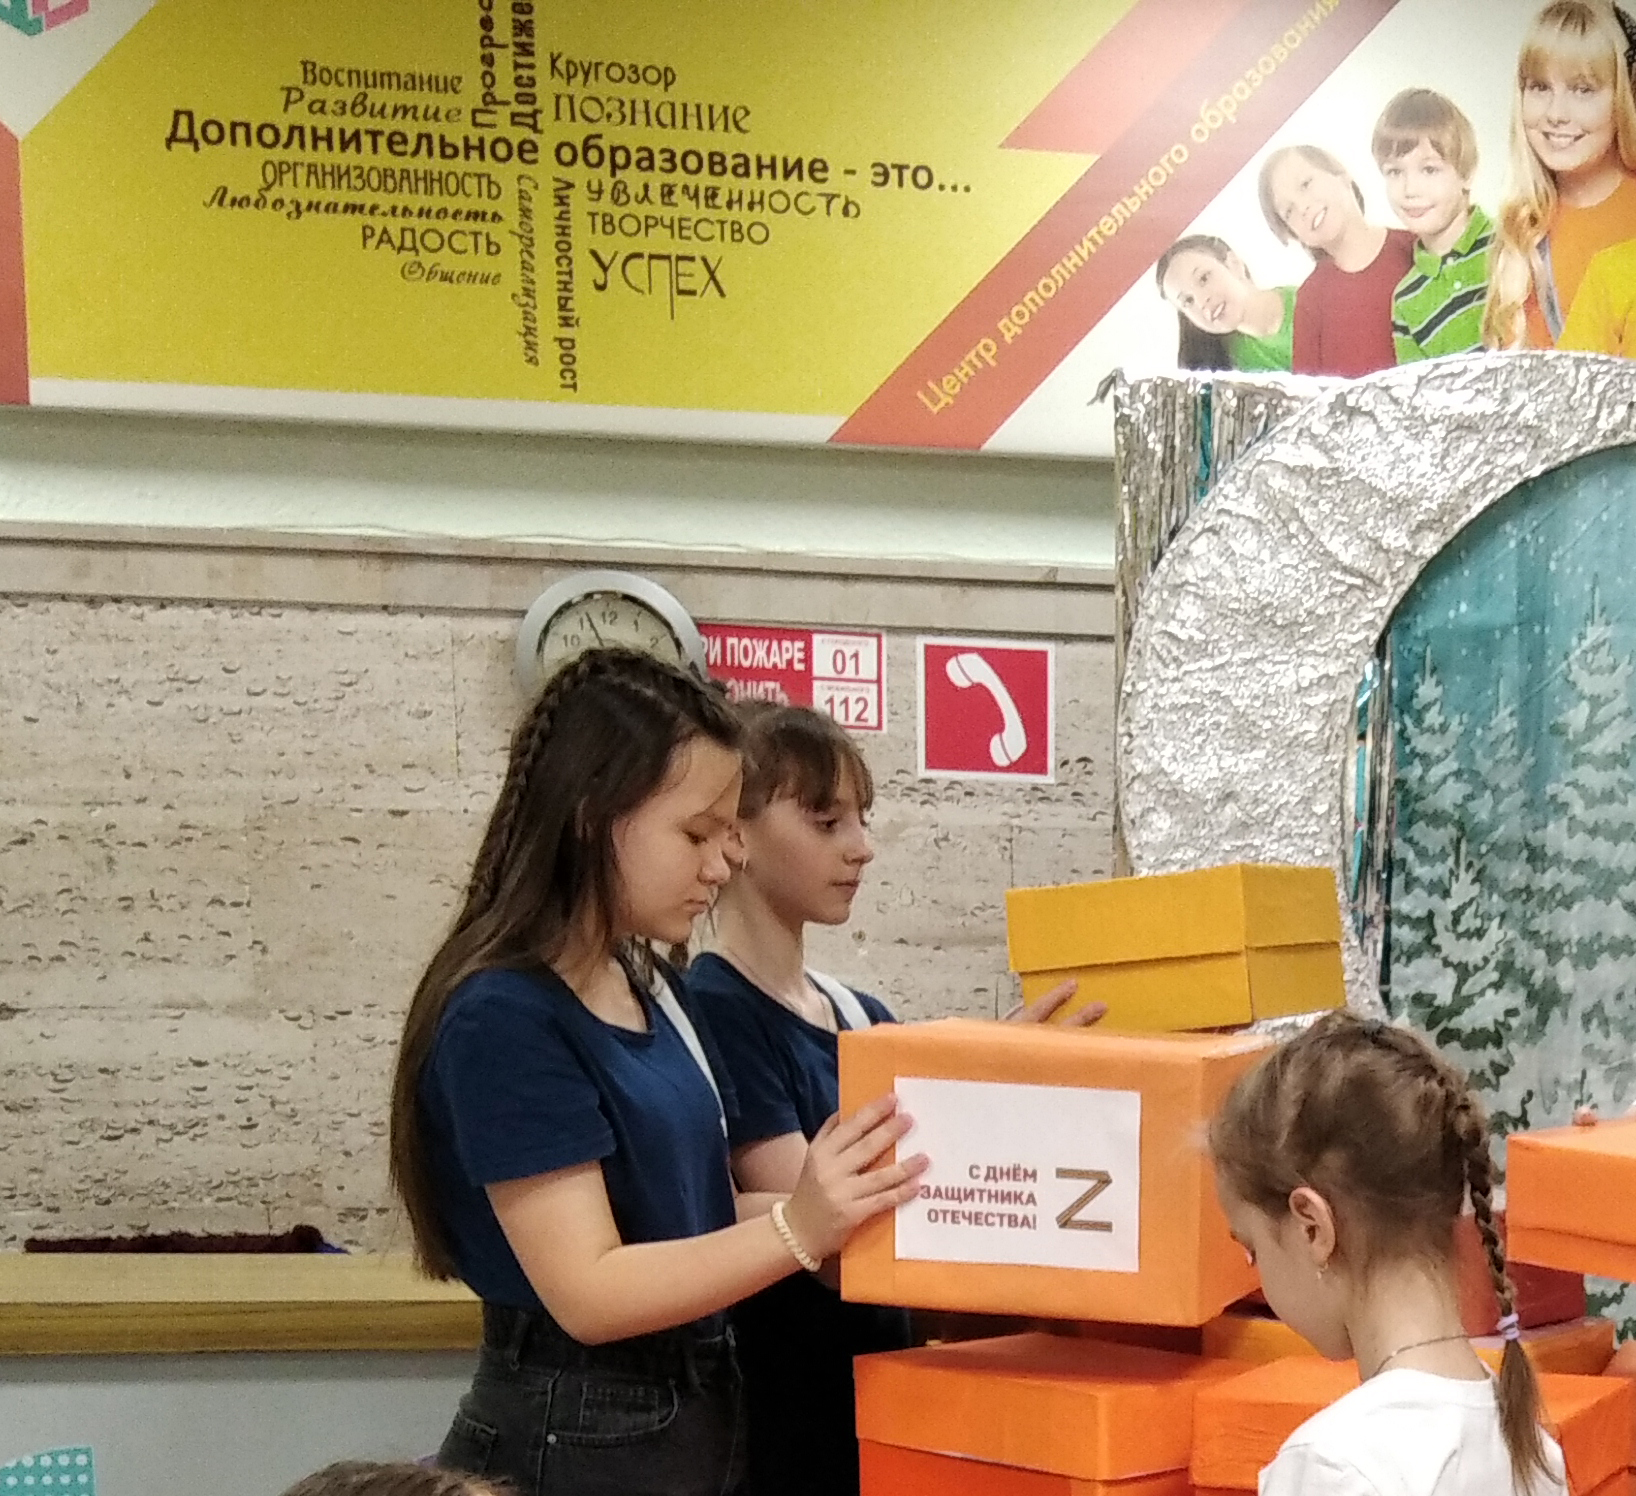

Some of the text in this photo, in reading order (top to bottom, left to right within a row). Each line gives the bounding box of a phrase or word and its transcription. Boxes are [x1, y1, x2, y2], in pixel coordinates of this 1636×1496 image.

[300, 60, 463, 94] Воспитание
[549, 51, 676, 92] Кругозор
[280, 86, 462, 123] Развитие
[165, 109, 540, 166] Дополнительное
[554, 133, 829, 184] образование
[261, 160, 502, 201] ОРГАНИЗОВАННОСТЬ
[361, 225, 502, 257] РАДОСТЬ
[586, 211, 770, 245] ТВОРЧЕСТВО
[552, 176, 581, 394] Личностный рост
[588, 248, 727, 321] УСПЕХ
[916, 338, 997, 415] Центр
[997, 143, 1190, 344] дополнительного
[725, 636, 806, 671] ПОЖАРЕ
[832, 649, 860, 676] 01
[824, 695, 869, 724] 112
[983, 1163, 1038, 1183] ДНЁМ
[919, 1184, 1038, 1207] ЗАЩИТНИКА
[1055, 1167, 1113, 1233] Z
[926, 1208, 1038, 1230] ОТЕЧЕСТВА!
